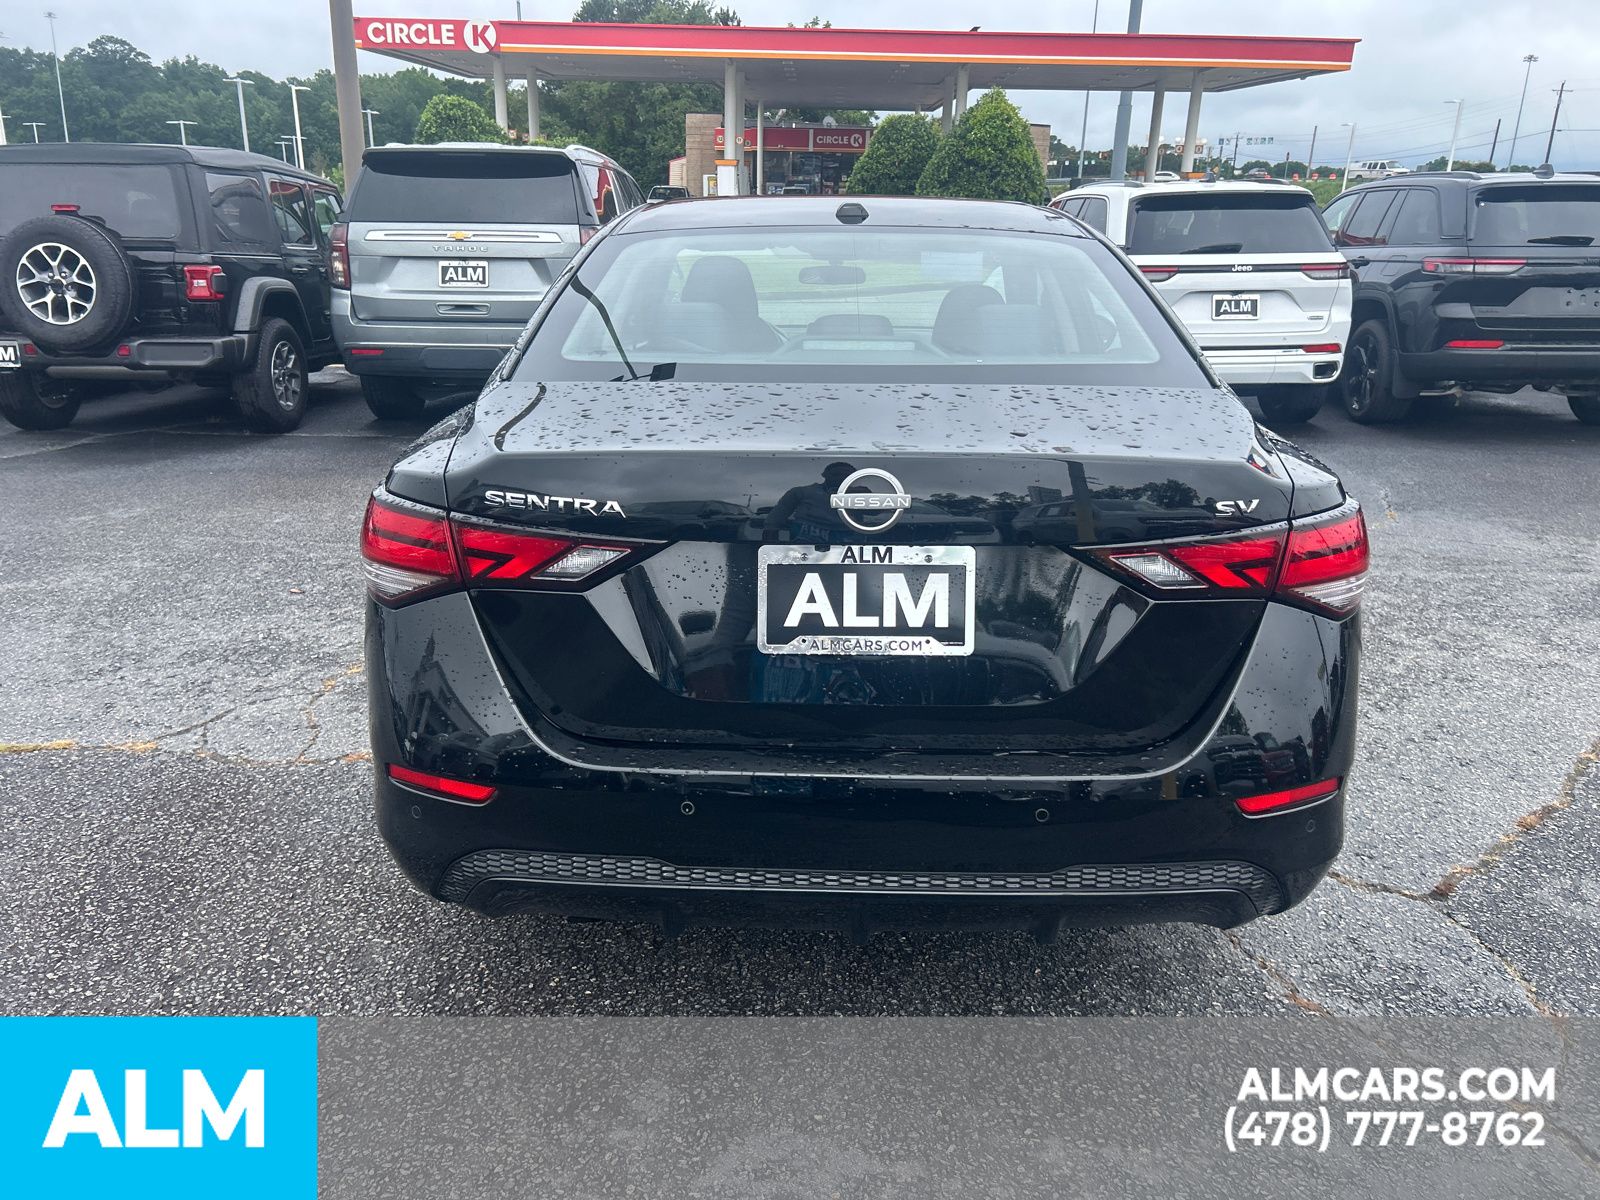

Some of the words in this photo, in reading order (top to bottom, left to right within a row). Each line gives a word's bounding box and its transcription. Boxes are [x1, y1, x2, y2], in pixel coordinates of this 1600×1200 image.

[367, 22, 456, 45] CIRCLE
[470, 24, 495, 50] K
[816, 135, 849, 144] CIRCLE
[852, 134, 862, 147] K
[444, 267, 483, 281] ALM
[1231, 264, 1253, 272] Jeep
[1219, 300, 1252, 313] ALM
[484, 490, 626, 518] SENTRA
[832, 497, 910, 507] NISSAN
[1215, 498, 1260, 517] SV
[841, 546, 893, 563] ALM
[783, 572, 949, 628] ALM
[809, 640, 922, 651] ALMCARS.COM
